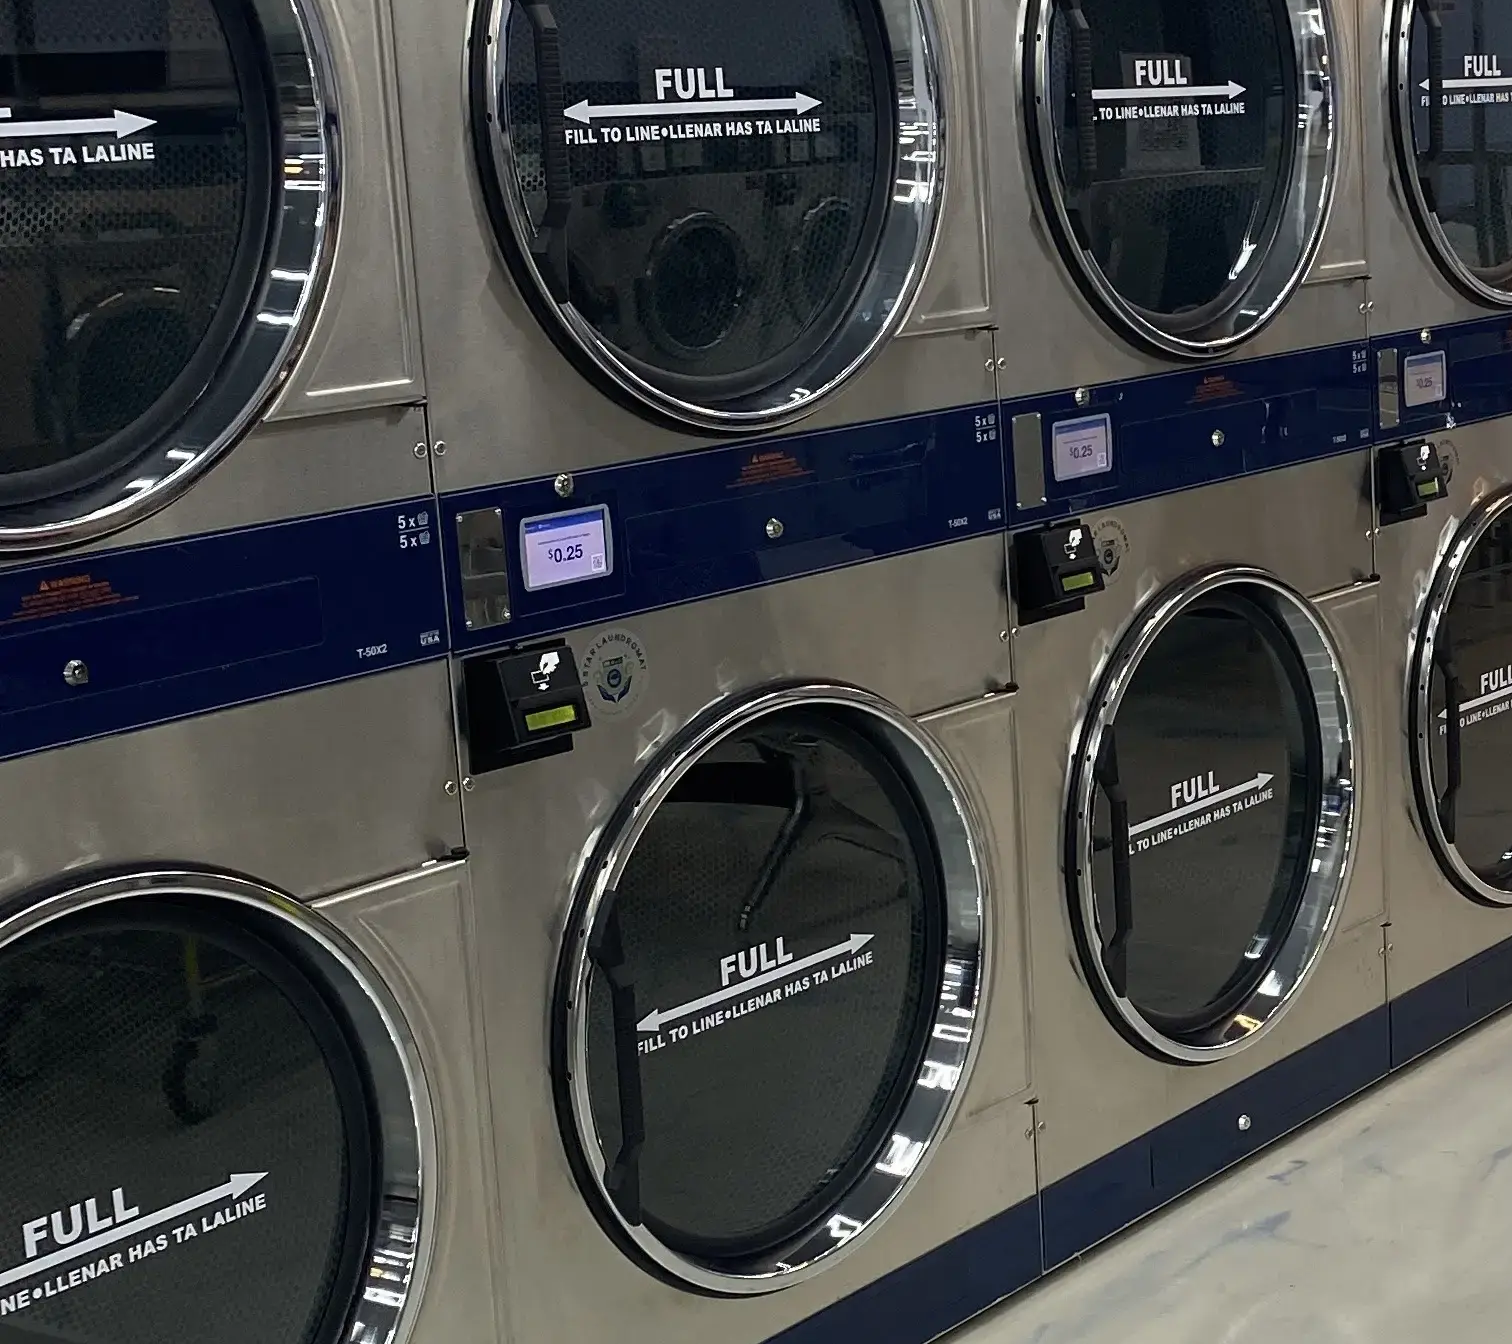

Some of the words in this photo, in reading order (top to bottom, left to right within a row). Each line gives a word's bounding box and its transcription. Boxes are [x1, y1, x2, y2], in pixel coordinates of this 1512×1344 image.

[1134, 59, 1187, 86] FULL
[1464, 55, 1501, 77] FULL
[654, 67, 734, 100] FULL
[1495, 92, 1509, 103] HAS
[1099, 107, 1113, 120] TO
[1181, 104, 1199, 116] HAS
[1201, 103, 1213, 115] TA
[565, 127, 597, 145] FILL
[601, 127, 622, 143] TO
[725, 121, 753, 136] HAS
[756, 119, 773, 134] TA
[0, 147, 43, 169] HAS
[48, 147, 77, 165] TA
[81, 142, 155, 164] LALINE
[975, 416, 980, 427] 5
[976, 431, 982, 442] 5
[1069, 444, 1093, 459] $0.25
[398, 515, 406, 529] 5
[409, 517, 416, 527] x
[400, 535, 408, 548] 5
[410, 537, 418, 547] x
[548, 544, 583, 563] $0.25
[356, 643, 388, 659] T-50X2
[596, 633, 647, 670] LAUNDROMAT
[1171, 771, 1220, 809] FULL
[1137, 839, 1149, 852] TO
[1213, 806, 1231, 823] HAS
[1232, 801, 1243, 814] TA
[720, 936, 793, 987] FULL
[669, 1024, 688, 1043] TO
[784, 977, 810, 998] HAS
[812, 970, 829, 985] TA
[22, 1187, 140, 1259] FULL
[128, 1234, 168, 1263] HAS
[171, 1223, 198, 1244] TA
